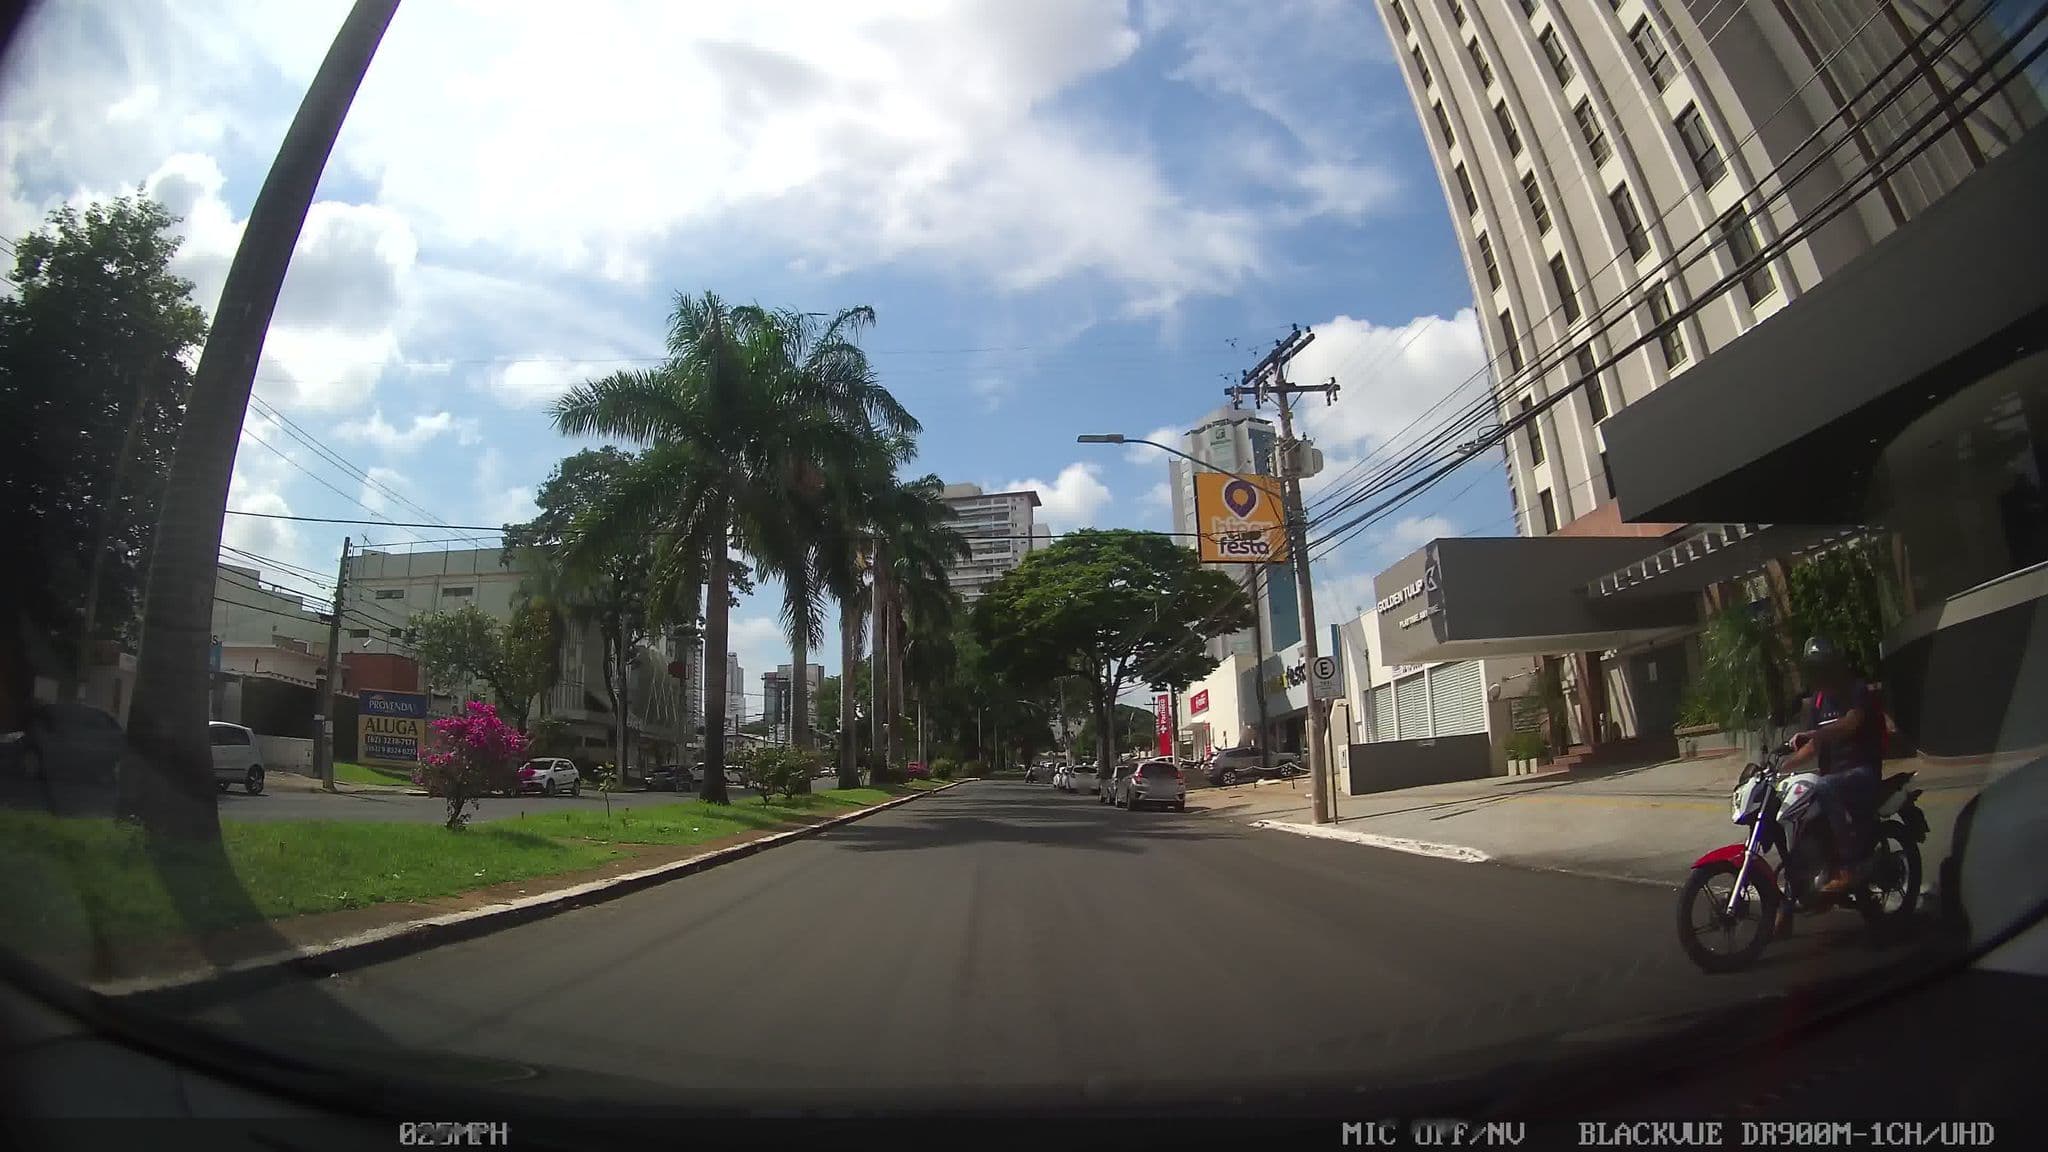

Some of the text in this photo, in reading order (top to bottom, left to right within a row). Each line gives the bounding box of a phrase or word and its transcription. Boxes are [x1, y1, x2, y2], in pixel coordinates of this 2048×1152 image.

[1220, 537, 1269, 554] festa
[1377, 579, 1423, 613] GOLDEN TULIP
[1320, 662, 1329, 675] E
[369, 700, 414, 712] PROVENDA
[365, 718, 418, 736] ALUGA
